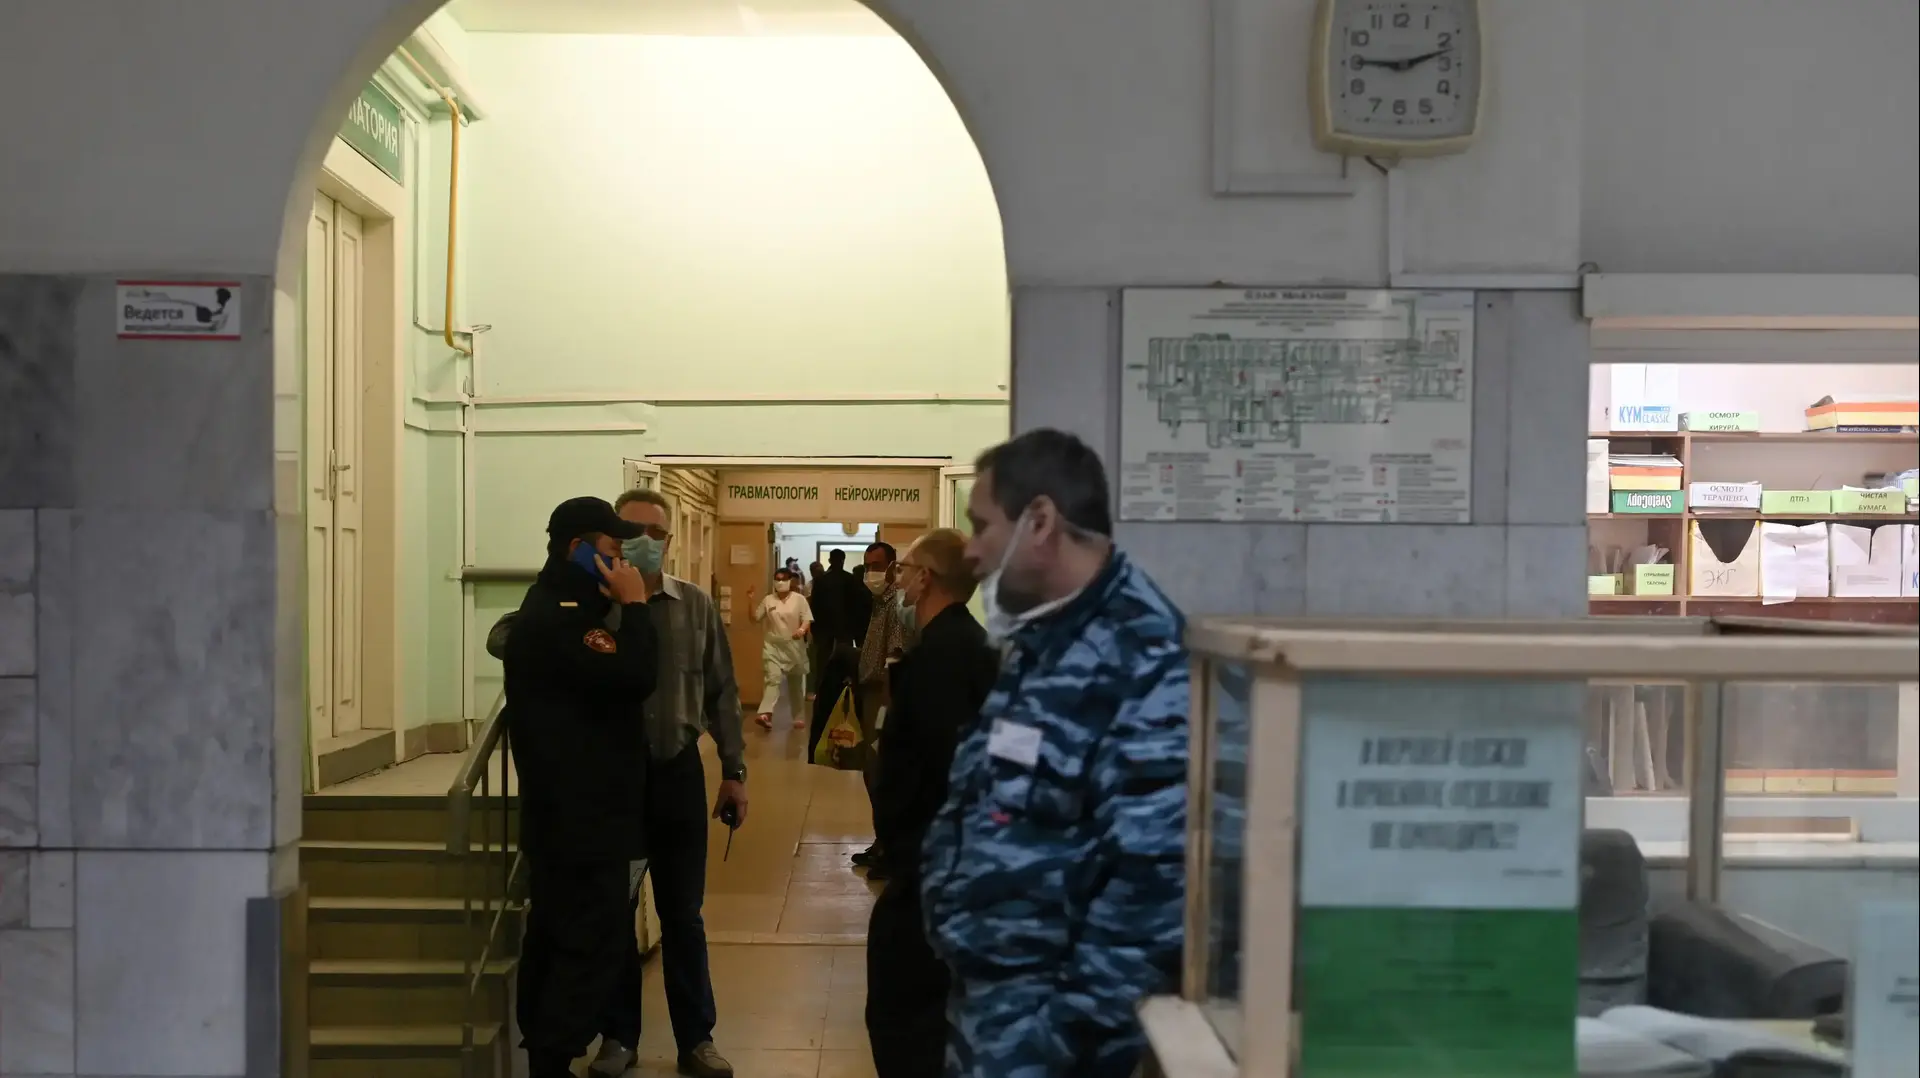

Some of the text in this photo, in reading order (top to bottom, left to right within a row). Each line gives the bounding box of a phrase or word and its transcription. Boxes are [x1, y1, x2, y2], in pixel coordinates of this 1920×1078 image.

[1371, 14, 1383, 30] 11
[1393, 13, 1410, 28] 12
[1424, 14, 1430, 30] 1
[1438, 32, 1451, 48] 2
[1437, 79, 1450, 96] 4
[1368, 97, 1382, 113] 7
[1392, 99, 1407, 115] 6
[1418, 98, 1433, 115] 5
[124, 304, 184, 321] Ведется
[728, 484, 920, 502] ТРАВМАТОЛОГИЯ НЕЙРОХИРУРГИЯ
[1709, 485, 1744, 493] ОСМОТР
[1626, 492, 1672, 509] SvetoCopy
[1703, 494, 1749, 502] ТЕРАПЕВТА
[1702, 568, 1737, 589] ЭКГ
